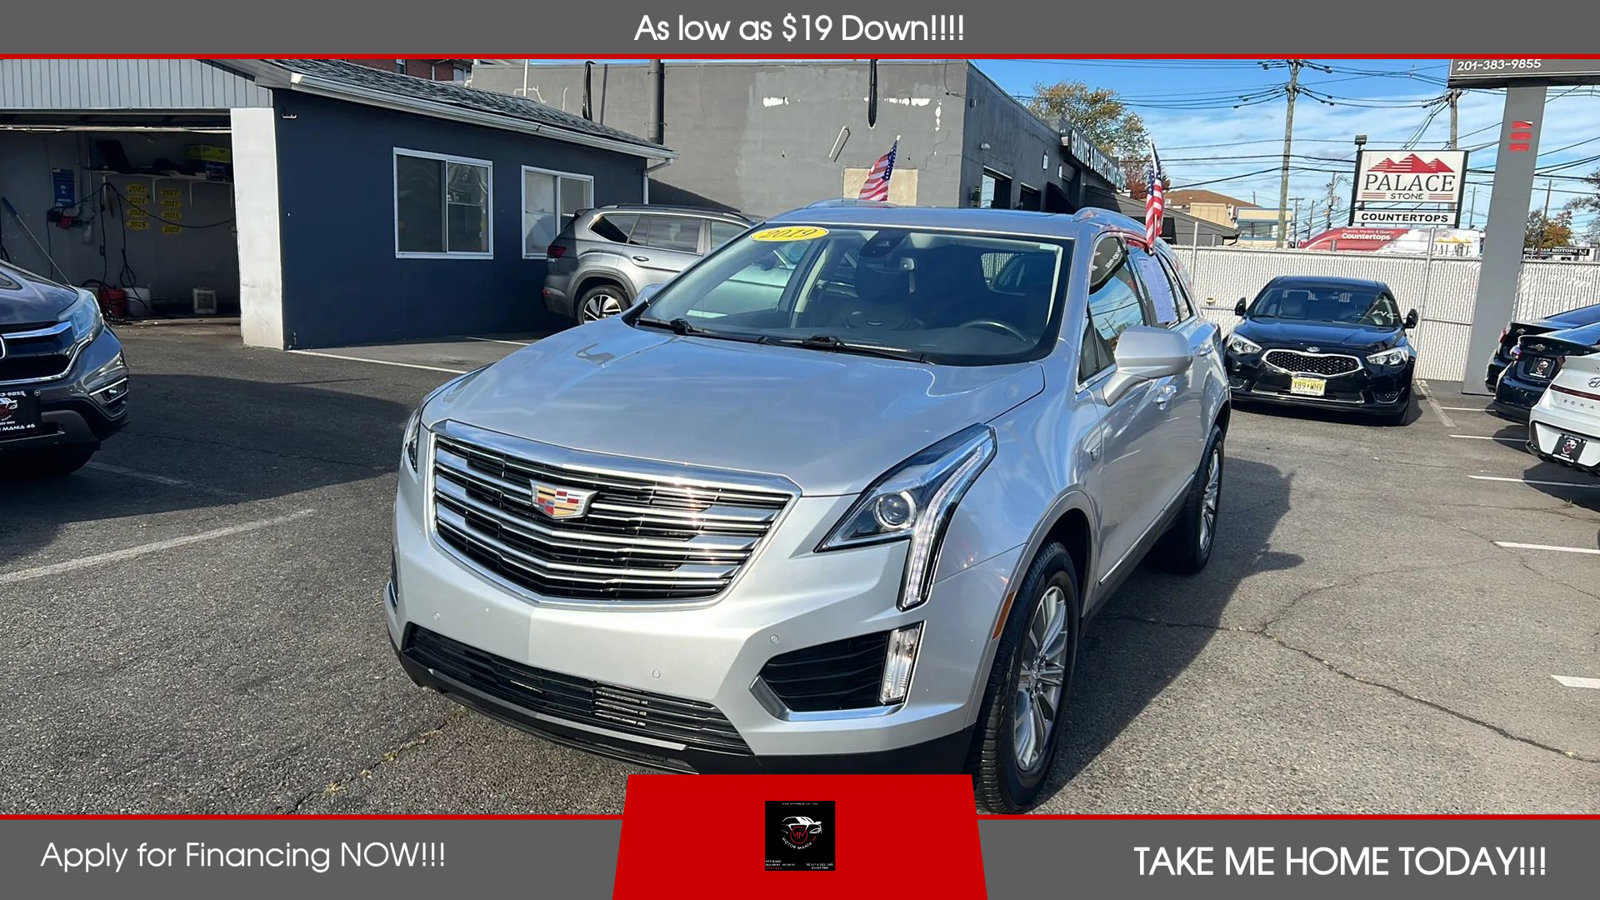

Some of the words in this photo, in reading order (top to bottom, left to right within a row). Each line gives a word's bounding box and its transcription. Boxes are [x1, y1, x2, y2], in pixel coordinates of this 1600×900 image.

[1457, 59, 1542, 71] 201-383-9855
[1364, 174, 1456, 192] PALACE
[1390, 192, 1424, 200] STONE
[1361, 212, 1449, 222] COUNTERTOPS
[760, 228, 819, 239] 2019
[1342, 232, 1391, 242] Countertops
